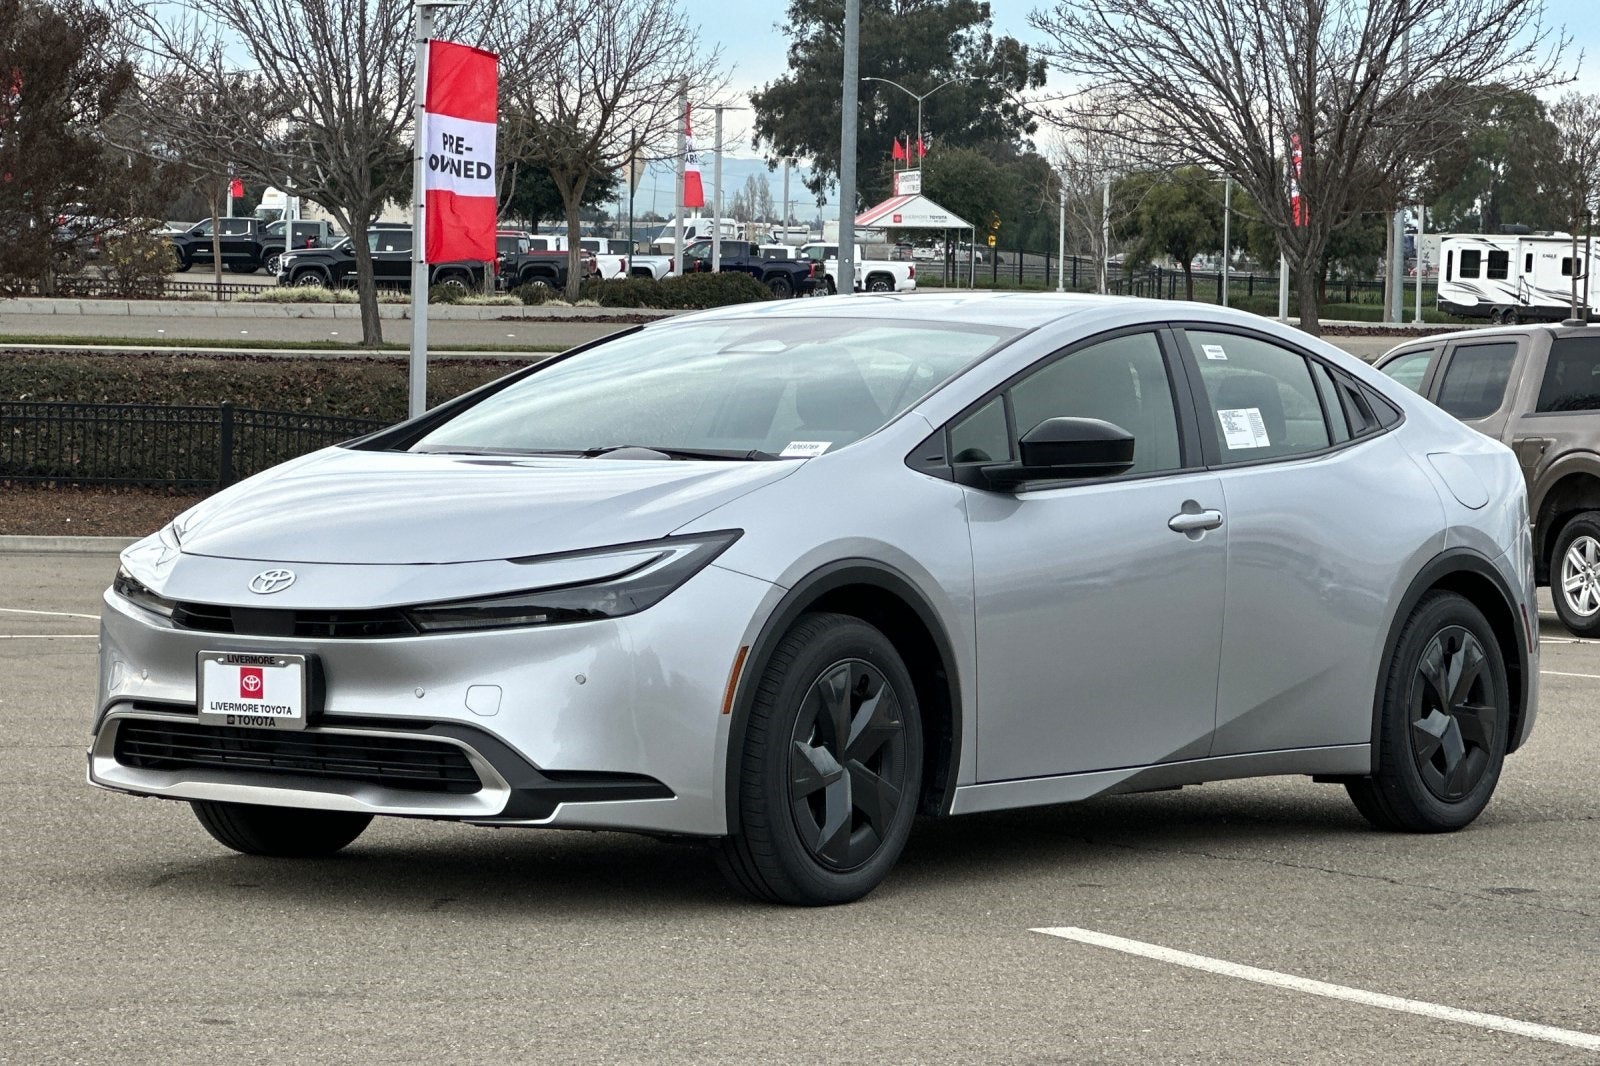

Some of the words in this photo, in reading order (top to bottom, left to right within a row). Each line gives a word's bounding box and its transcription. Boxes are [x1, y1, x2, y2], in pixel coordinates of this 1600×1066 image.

[442, 132, 473, 155] PRE-
[428, 153, 492, 180] OWNED
[227, 655, 275, 665] LIVERMORE
[210, 701, 258, 713] LIVERMORE
[260, 704, 292, 715] TOYOTA
[237, 716, 276, 727] TOYOTA
